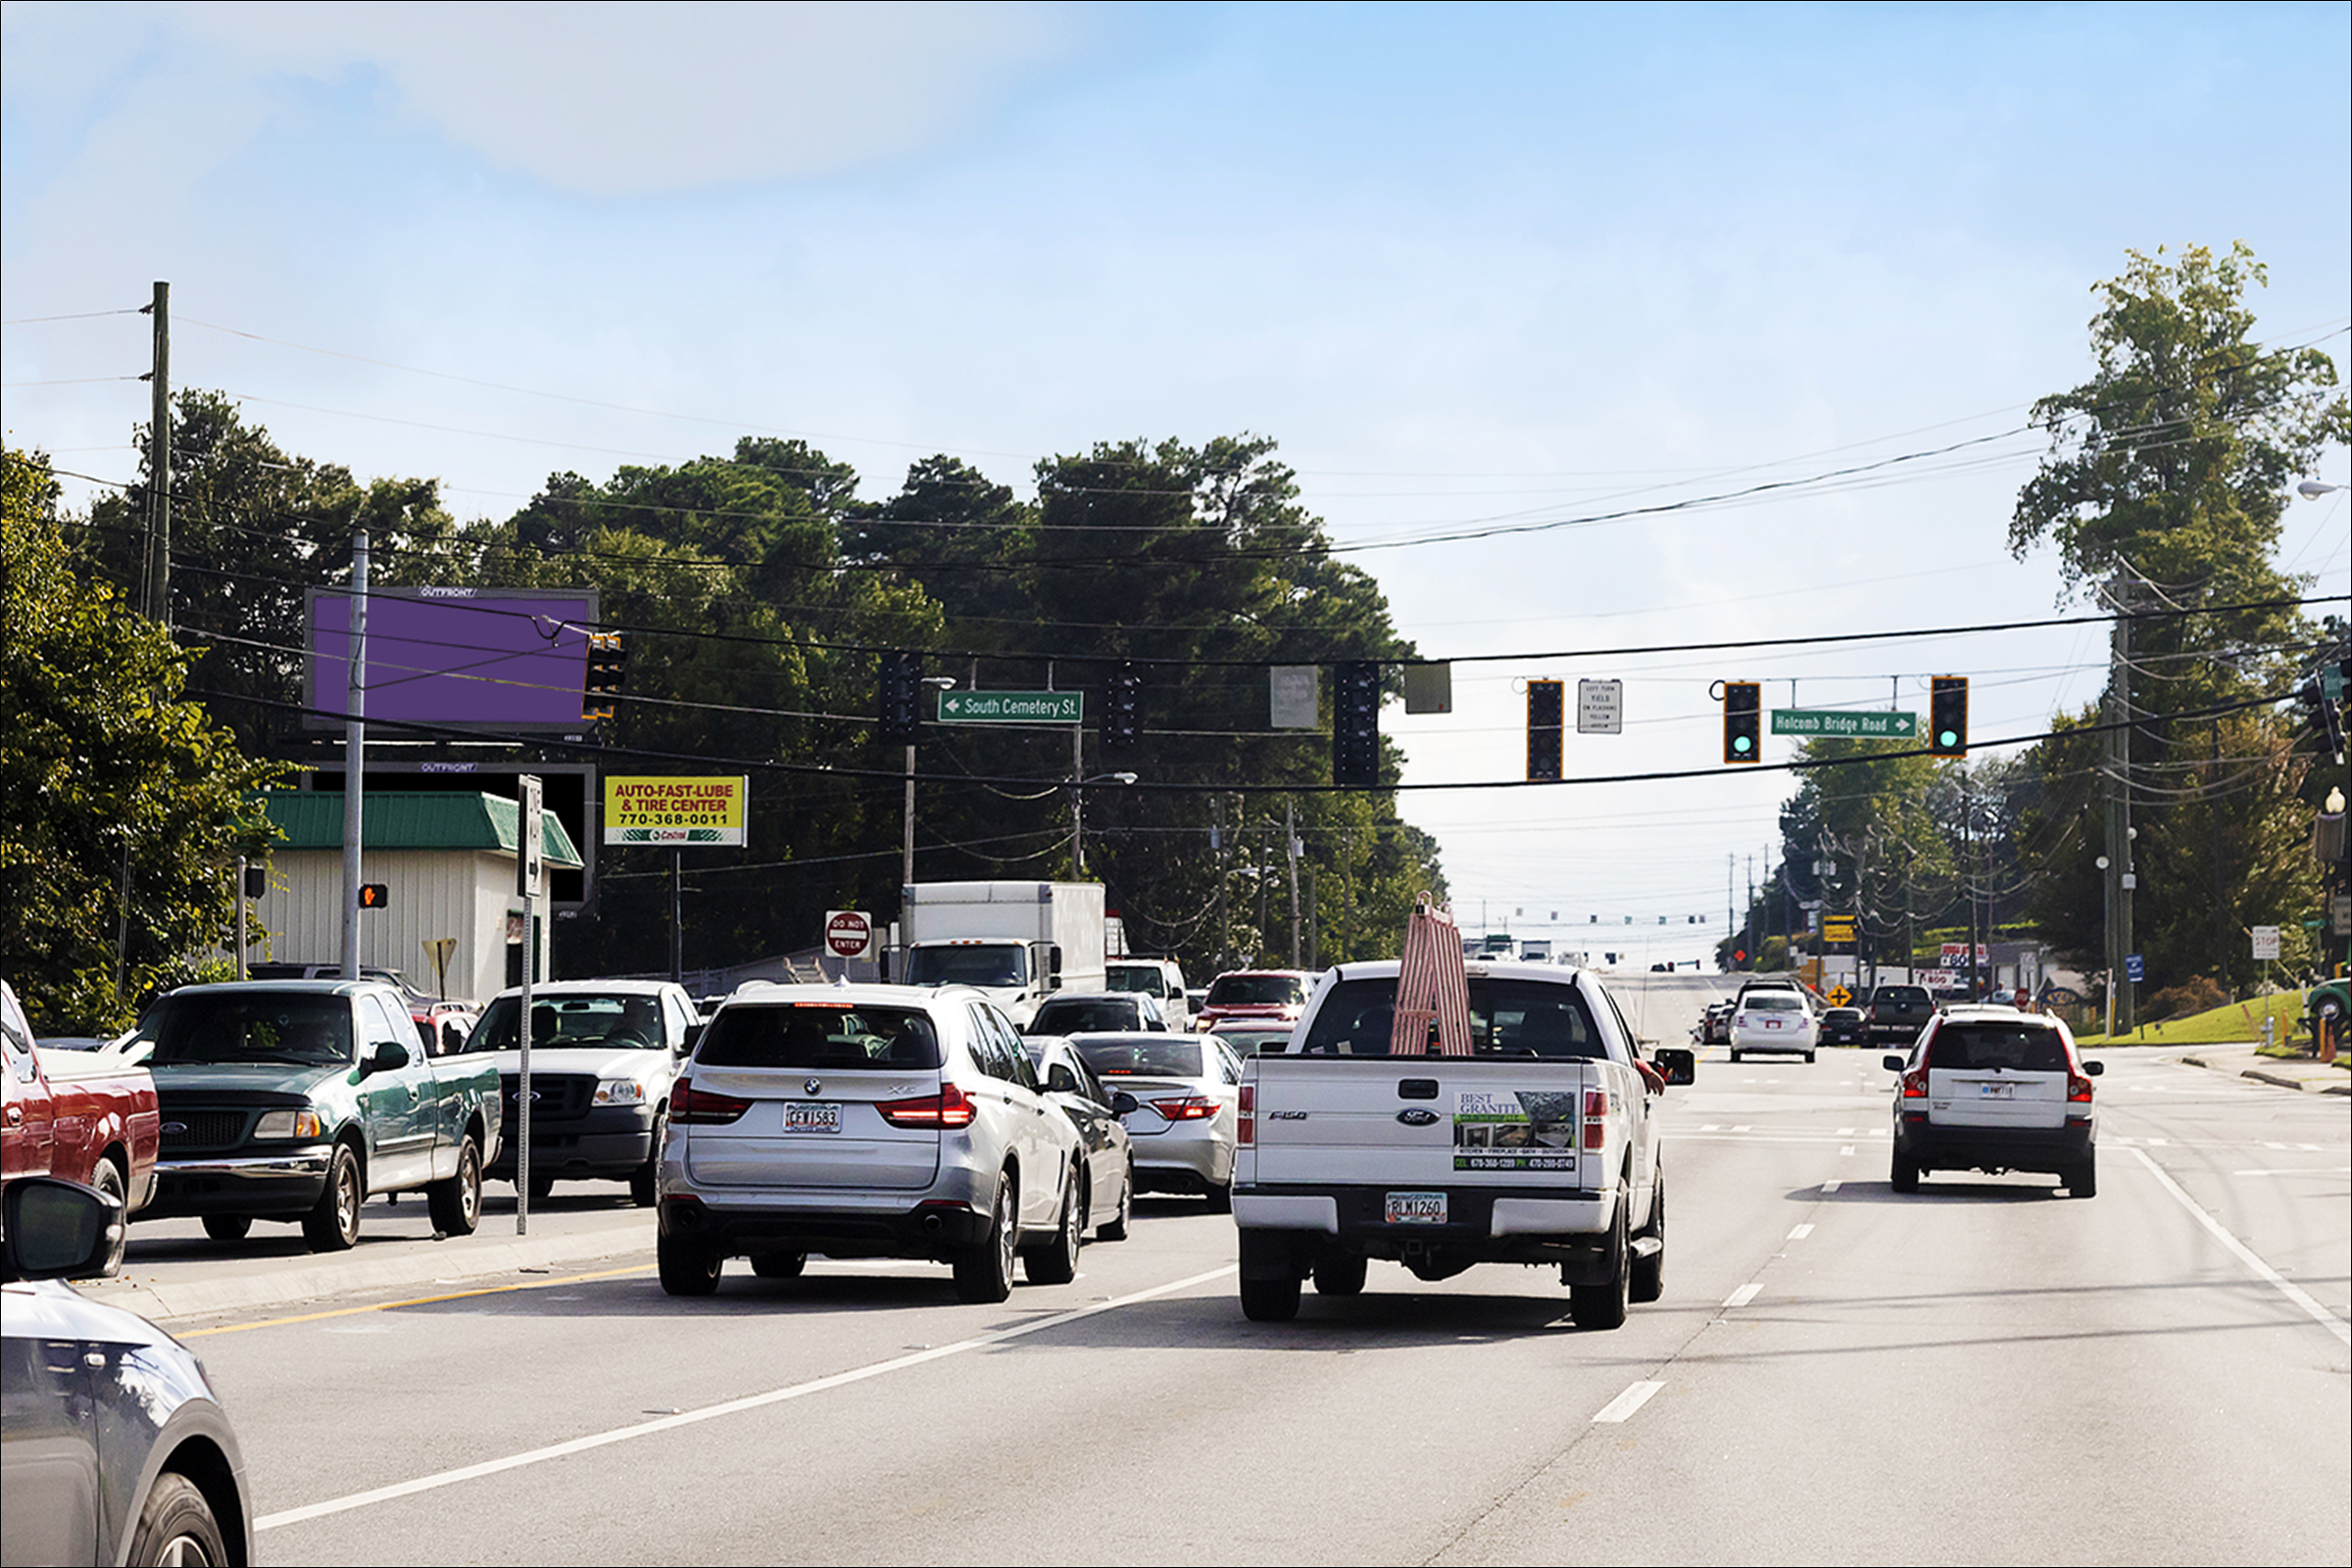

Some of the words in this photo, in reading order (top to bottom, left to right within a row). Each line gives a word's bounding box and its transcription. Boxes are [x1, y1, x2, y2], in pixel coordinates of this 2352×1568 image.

[964, 698, 1000, 714] South
[1003, 698, 1059, 717] Cemetery
[1777, 715, 1820, 730] Holcomb
[1824, 716, 1858, 735] Bridge
[1862, 716, 1887, 731] Road
[615, 785, 733, 798] AUTO-FAST-LUBE
[621, 799, 632, 811] &
[636, 799, 667, 811] TIRE
[670, 799, 727, 811] CENTER
[619, 813, 727, 825] 770-368-0011
[833, 919, 845, 928] DO
[848, 920, 864, 929] NOT
[835, 940, 861, 950] ENTER
[1460, 1093, 1494, 1103] BEST
[1459, 1103, 1520, 1114] GRANITE
